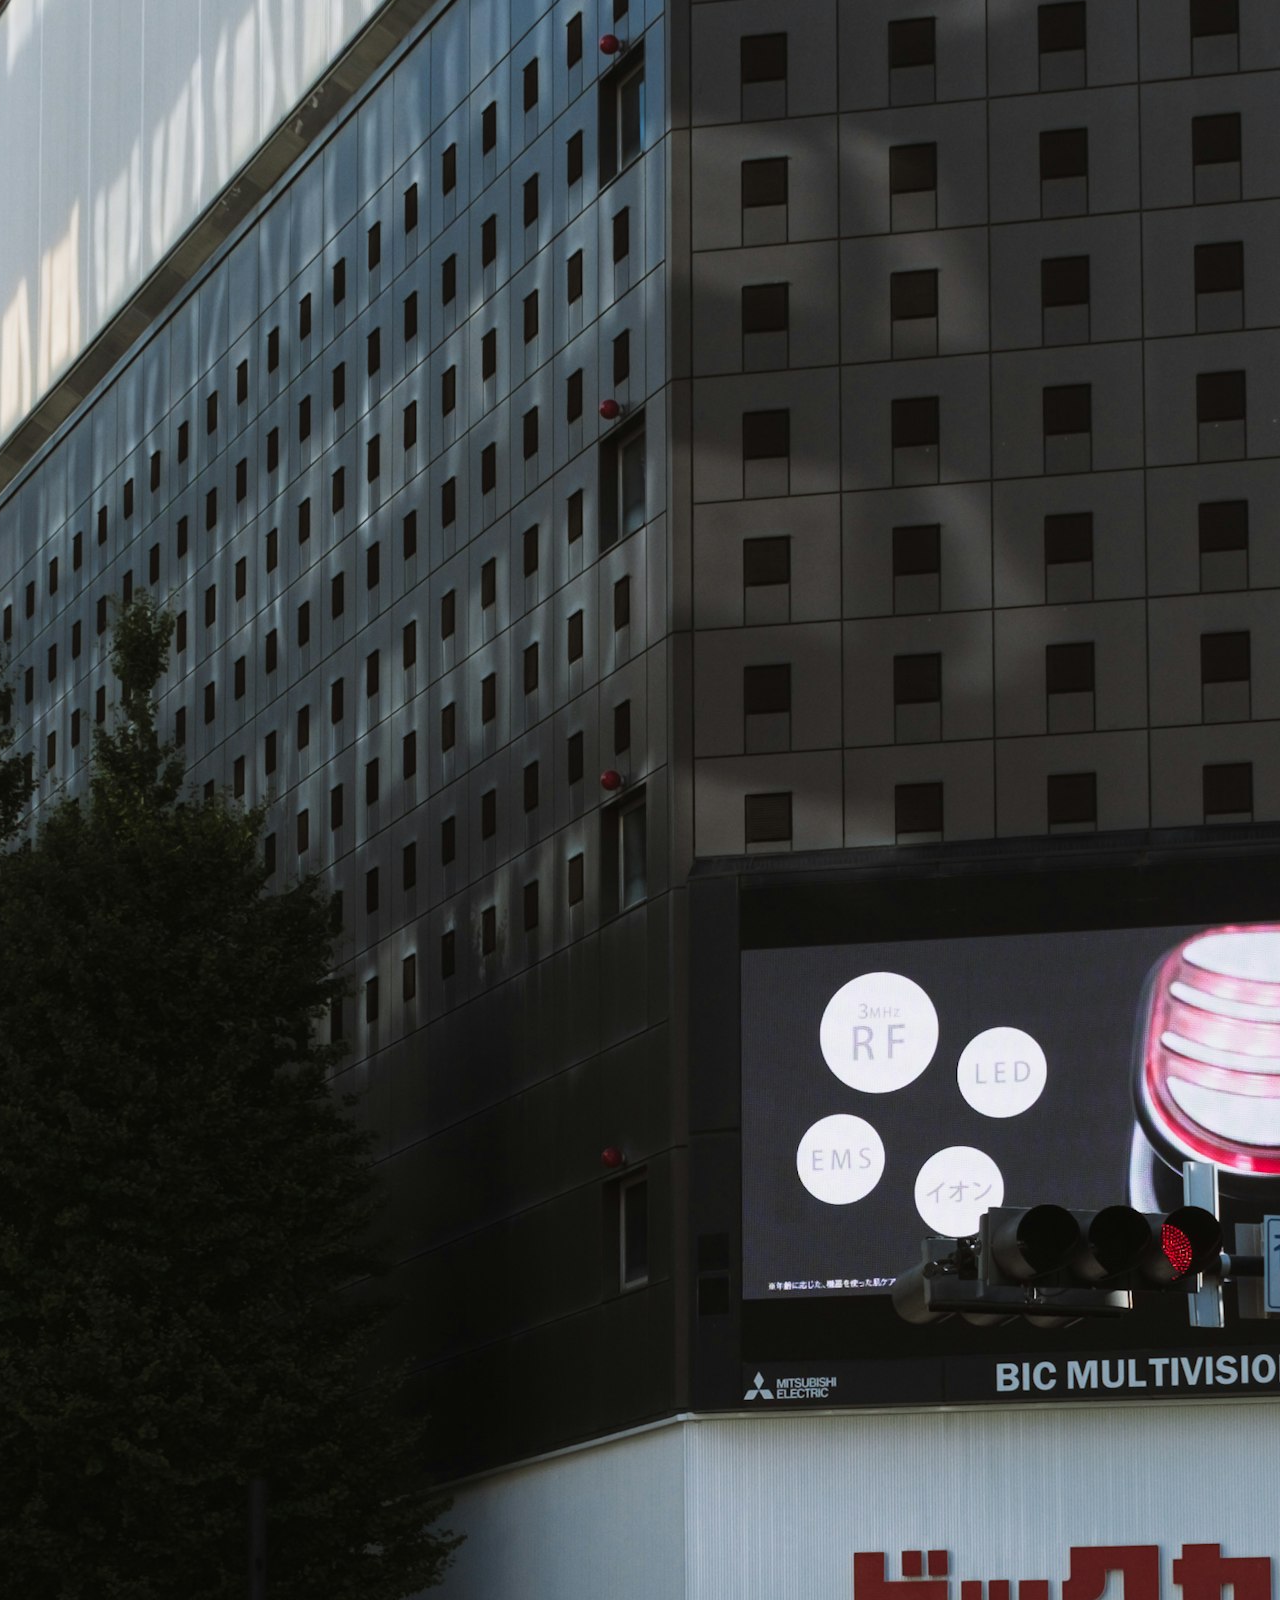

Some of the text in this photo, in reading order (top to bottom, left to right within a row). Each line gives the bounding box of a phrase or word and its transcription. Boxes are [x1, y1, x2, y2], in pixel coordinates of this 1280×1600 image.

[857, 1003, 901, 1019] 3MHz
[852, 1023, 906, 1061] RF
[975, 1060, 1031, 1084] LED
[811, 1147, 871, 1171] EMS
[926, 1180, 993, 1204] イオン
[776, 1376, 837, 1389] MITSUBISHI
[996, 1361, 1057, 1392] BIC
[776, 1387, 829, 1399] ELECTRIC
